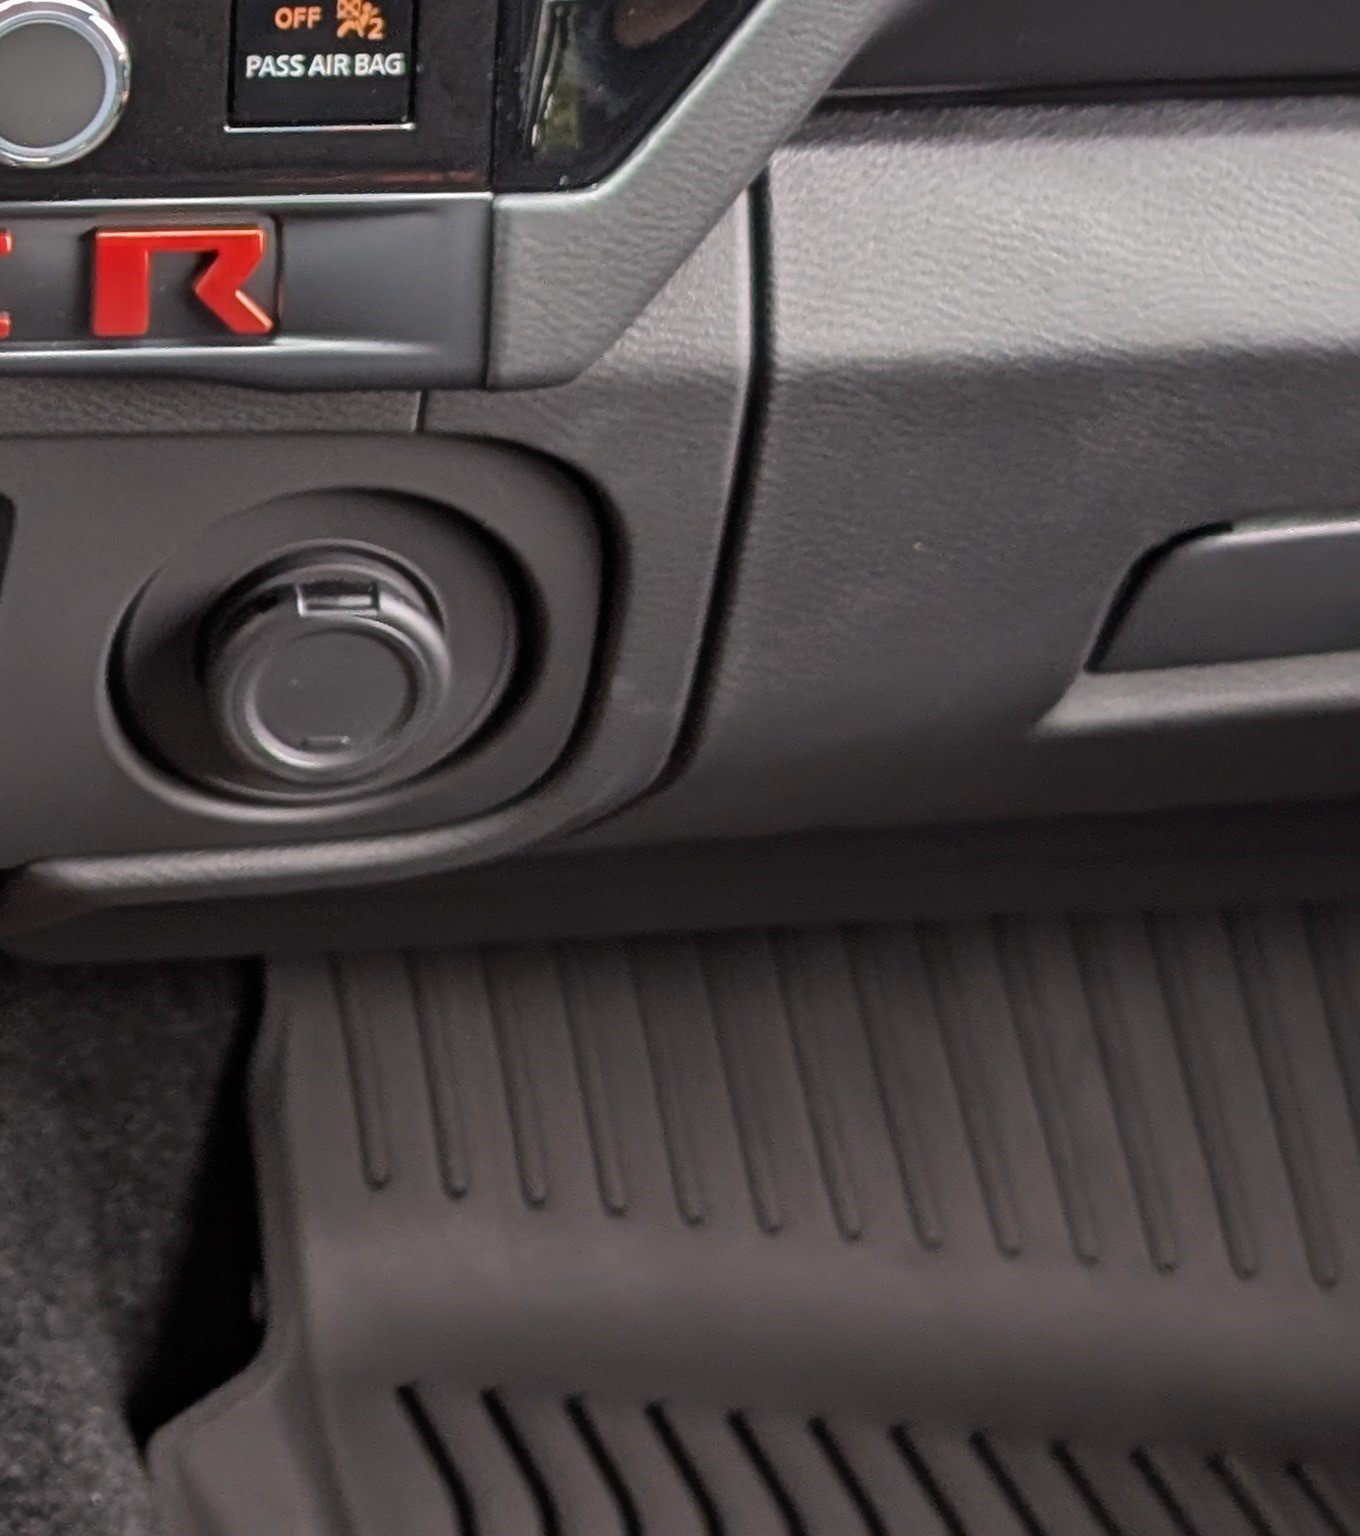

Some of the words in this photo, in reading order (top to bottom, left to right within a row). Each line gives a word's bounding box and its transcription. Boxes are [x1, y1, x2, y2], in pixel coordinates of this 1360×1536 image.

[274, 7, 322, 30] OFF
[245, 54, 306, 78] PASS
[308, 53, 351, 77] AIR
[354, 52, 406, 76] BAG
